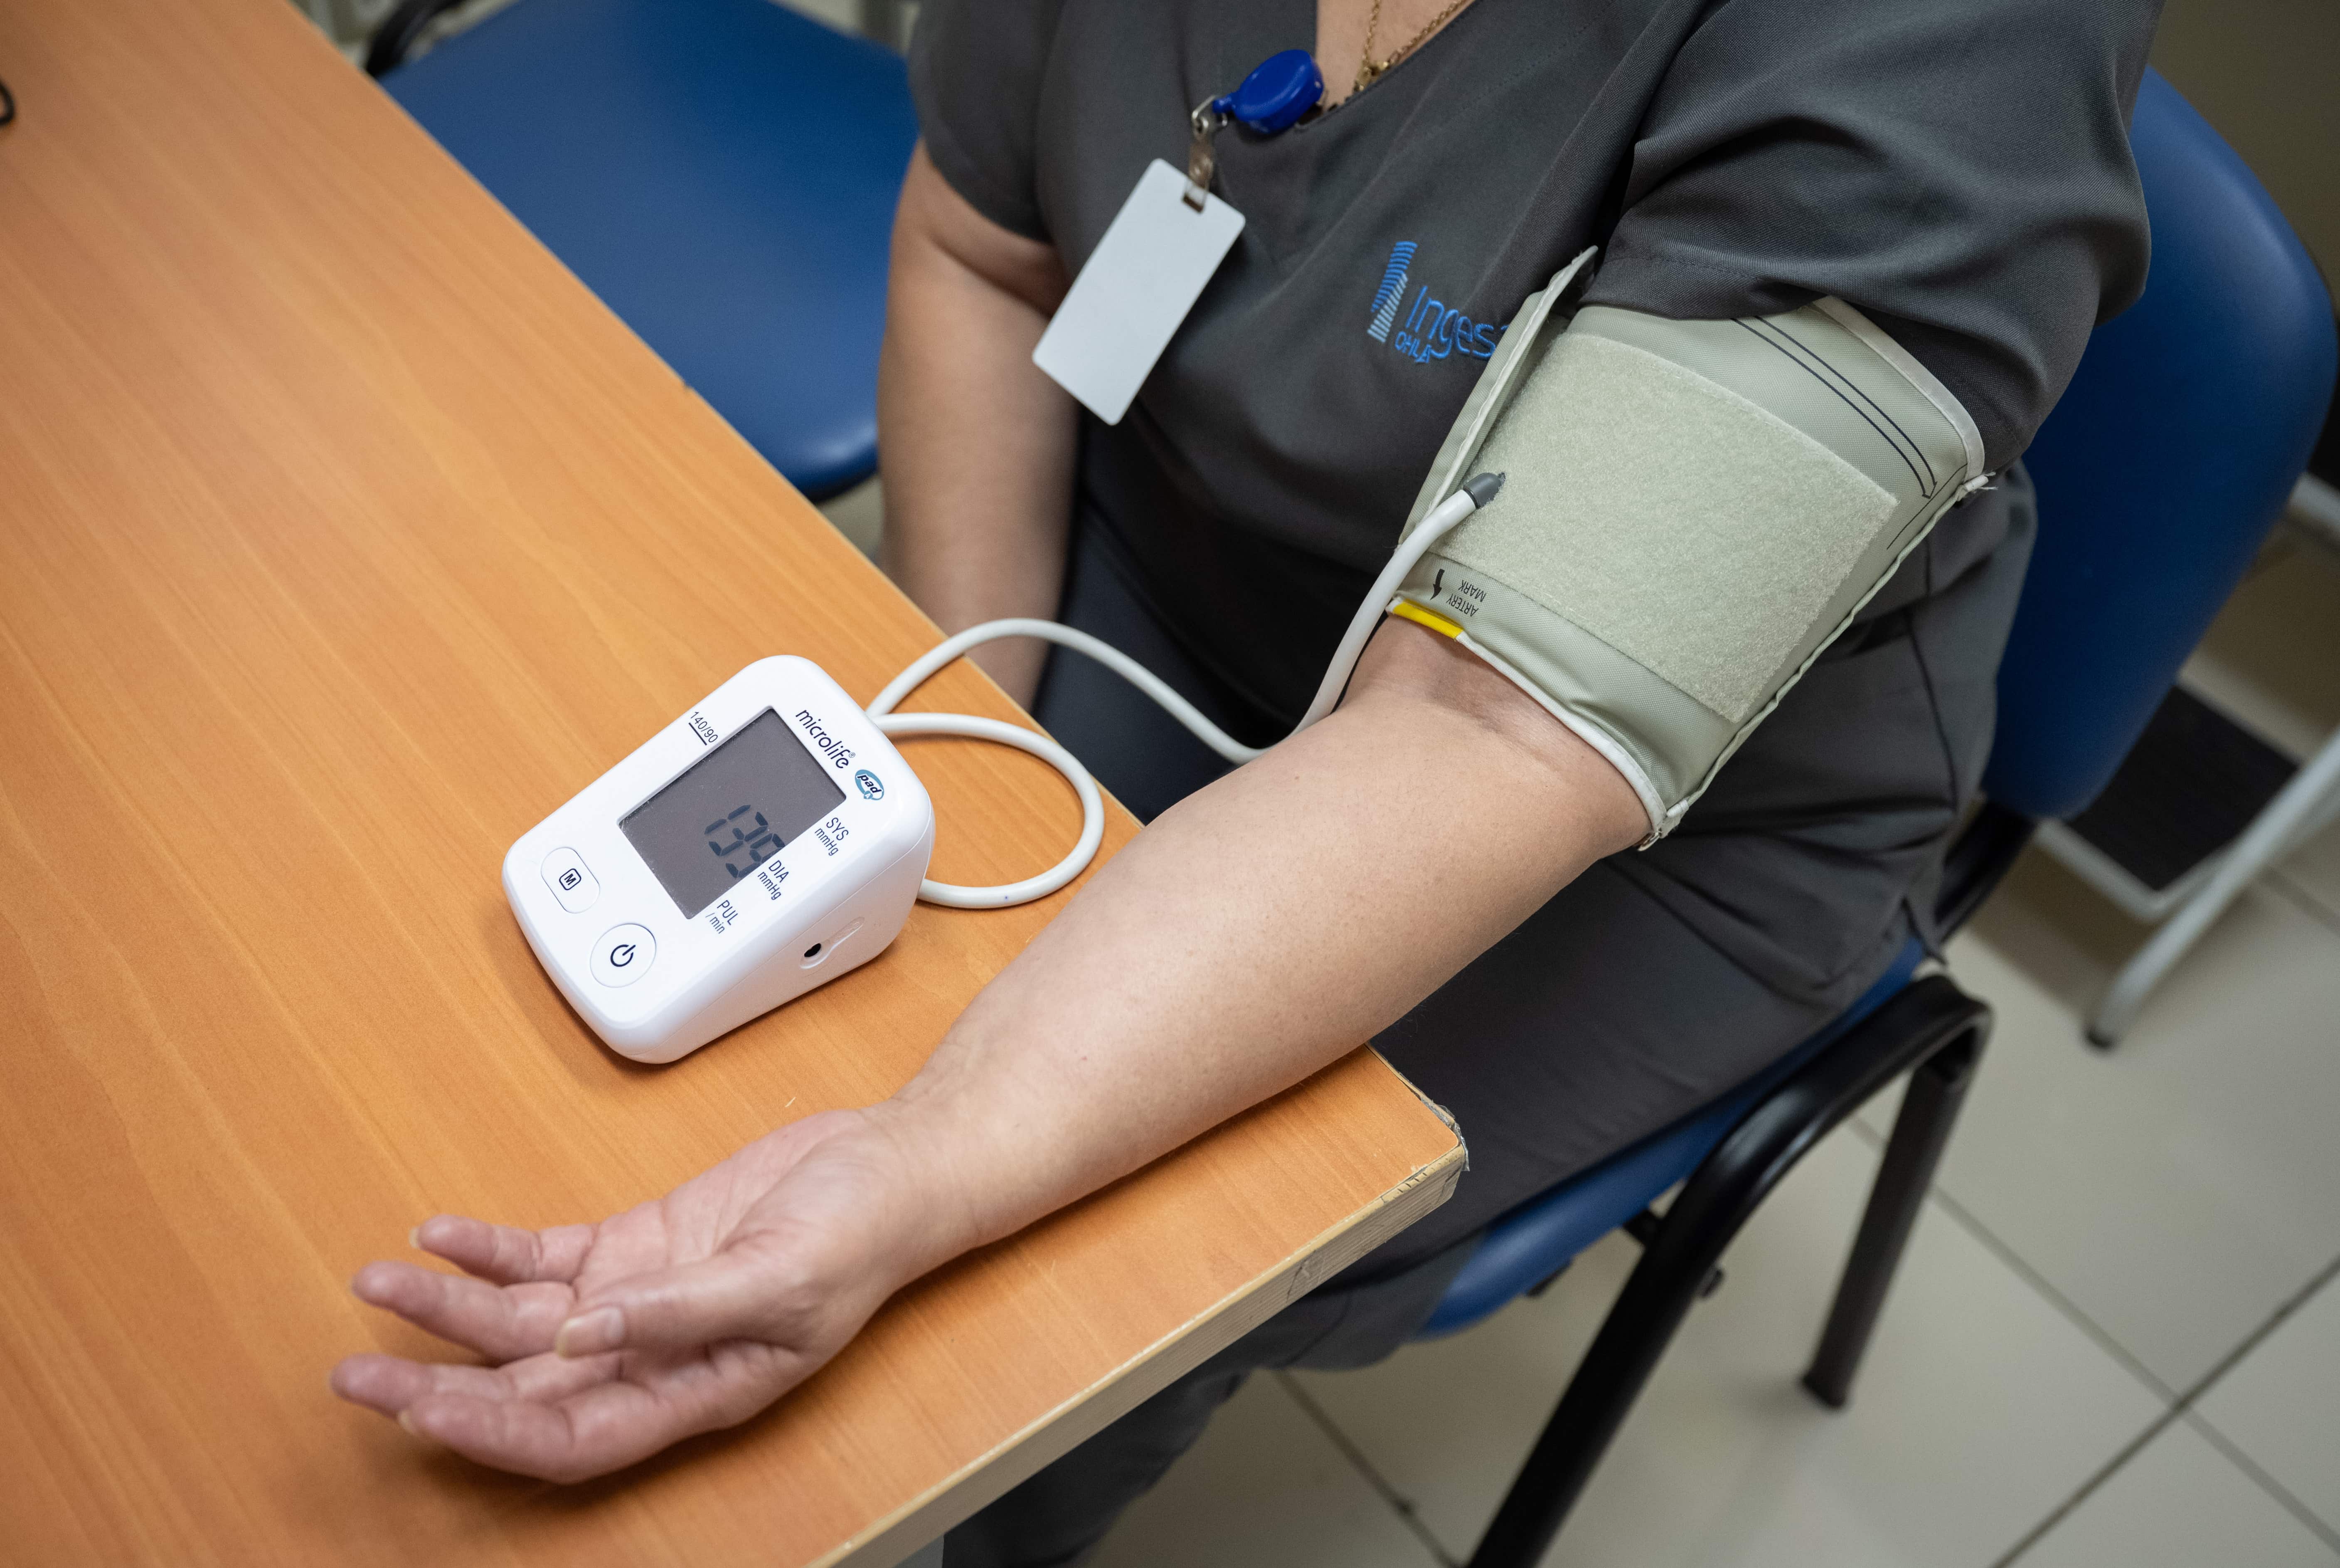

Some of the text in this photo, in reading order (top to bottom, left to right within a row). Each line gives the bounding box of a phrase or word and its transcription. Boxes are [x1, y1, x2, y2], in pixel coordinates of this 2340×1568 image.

[1406, 286, 1509, 359] Inges
[1458, 580, 1486, 602] MARK
[1446, 593, 1479, 617] ARTERY
[691, 712, 718, 743] 140/90
[857, 775, 882, 793] pad
[826, 817, 849, 840] SYS
[704, 805, 785, 879] 139
[815, 828, 839, 856] mmHg
[564, 874, 576, 885] M
[769, 860, 789, 883] DIA
[757, 872, 781, 900] mmHg
[717, 900, 738, 925] PUL
